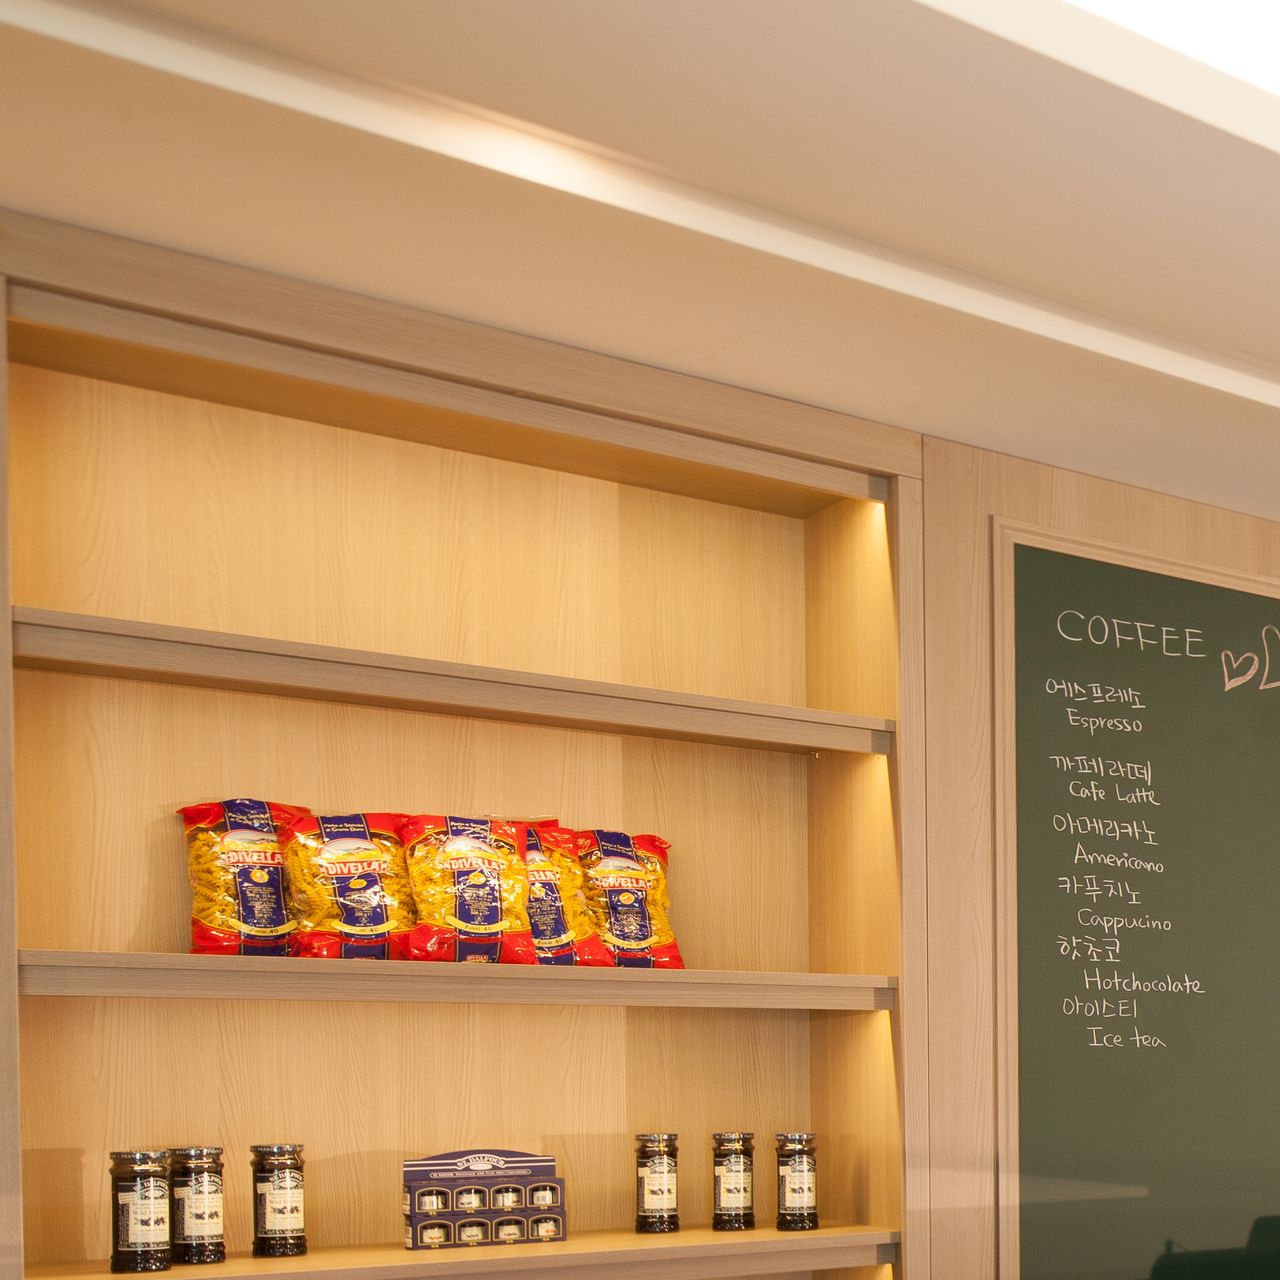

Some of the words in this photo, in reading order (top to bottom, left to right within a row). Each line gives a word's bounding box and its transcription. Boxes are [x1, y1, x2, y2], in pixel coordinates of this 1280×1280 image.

[1057, 610, 1206, 657] COFFEE
[1066, 708, 1143, 736] Espresso
[1069, 780, 1106, 801] Cafe
[1115, 783, 1161, 806] Latte
[1053, 813, 1158, 845] 아메리카노
[228, 850, 283, 864] DIVELLA
[327, 860, 381, 875] DIVELLA
[1074, 842, 1164, 873] Americano
[1058, 875, 1141, 904] 카푸치노
[1077, 909, 1171, 936] Cappucino
[1056, 935, 1121, 962] 핫초코
[1084, 967, 1206, 994] Hotchocolate
[1063, 998, 1137, 1018] 아이스티
[1087, 1027, 1123, 1047] Ice
[1130, 1026, 1166, 1048] tea
